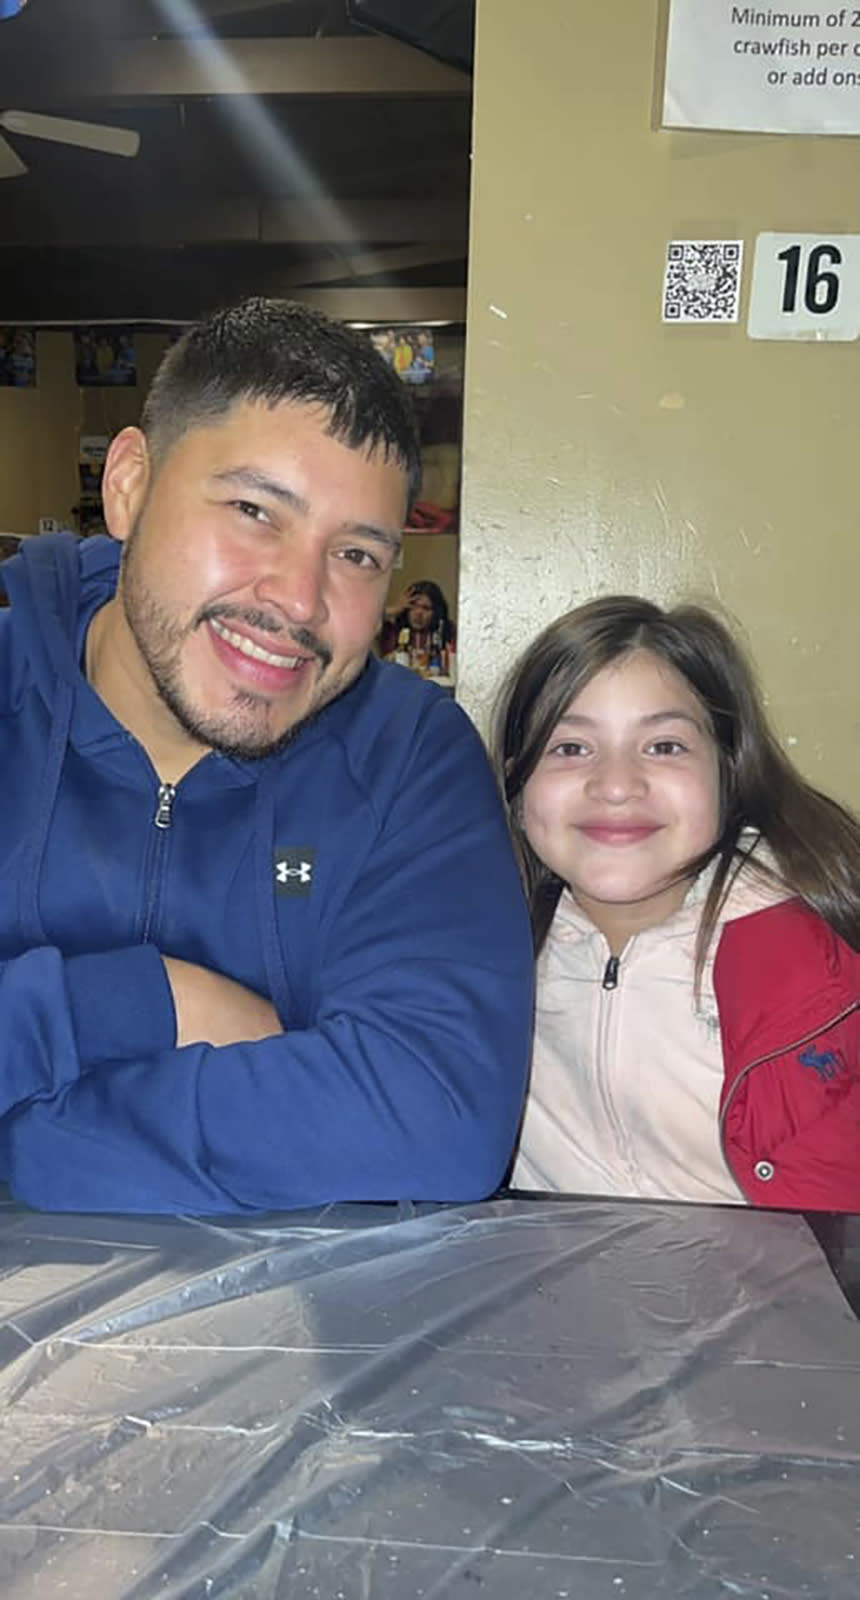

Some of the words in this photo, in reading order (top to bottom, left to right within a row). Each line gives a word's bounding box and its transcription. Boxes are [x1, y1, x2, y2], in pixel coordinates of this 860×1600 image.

[731, 6, 820, 27] Minimum
[826, 9, 846, 27] of
[733, 37, 811, 56] crawfish
[816, 42, 849, 60] per
[767, 70, 787, 85] or
[792, 67, 828, 85] add
[777, 244, 843, 315] 16
